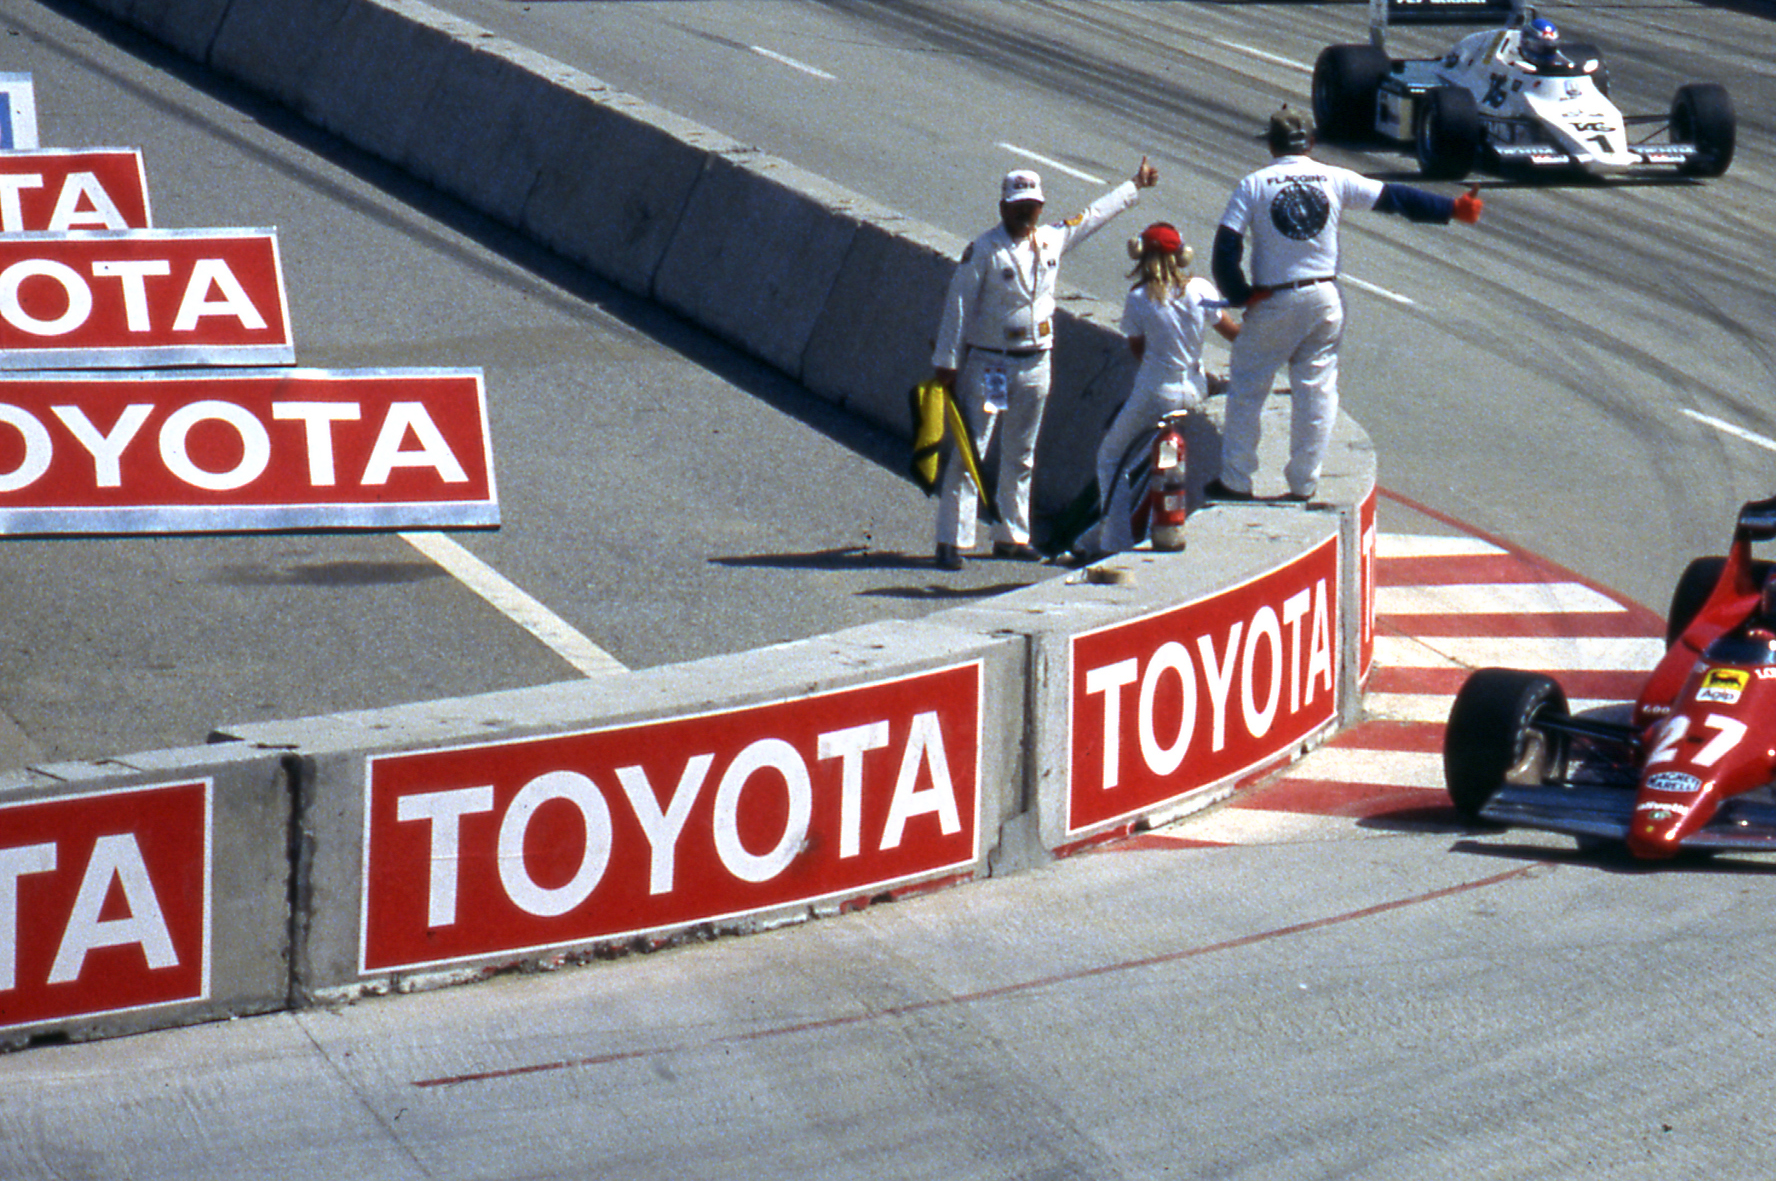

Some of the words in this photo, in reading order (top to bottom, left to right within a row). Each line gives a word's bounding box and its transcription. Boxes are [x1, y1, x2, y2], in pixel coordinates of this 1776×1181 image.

[1586, 134, 1616, 153] 1
[1086, 578, 1332, 790] TOYOTA
[1701, 690, 1734, 700] Agip
[1646, 714, 1748, 768] 27
[397, 711, 961, 929] TOYOTA
